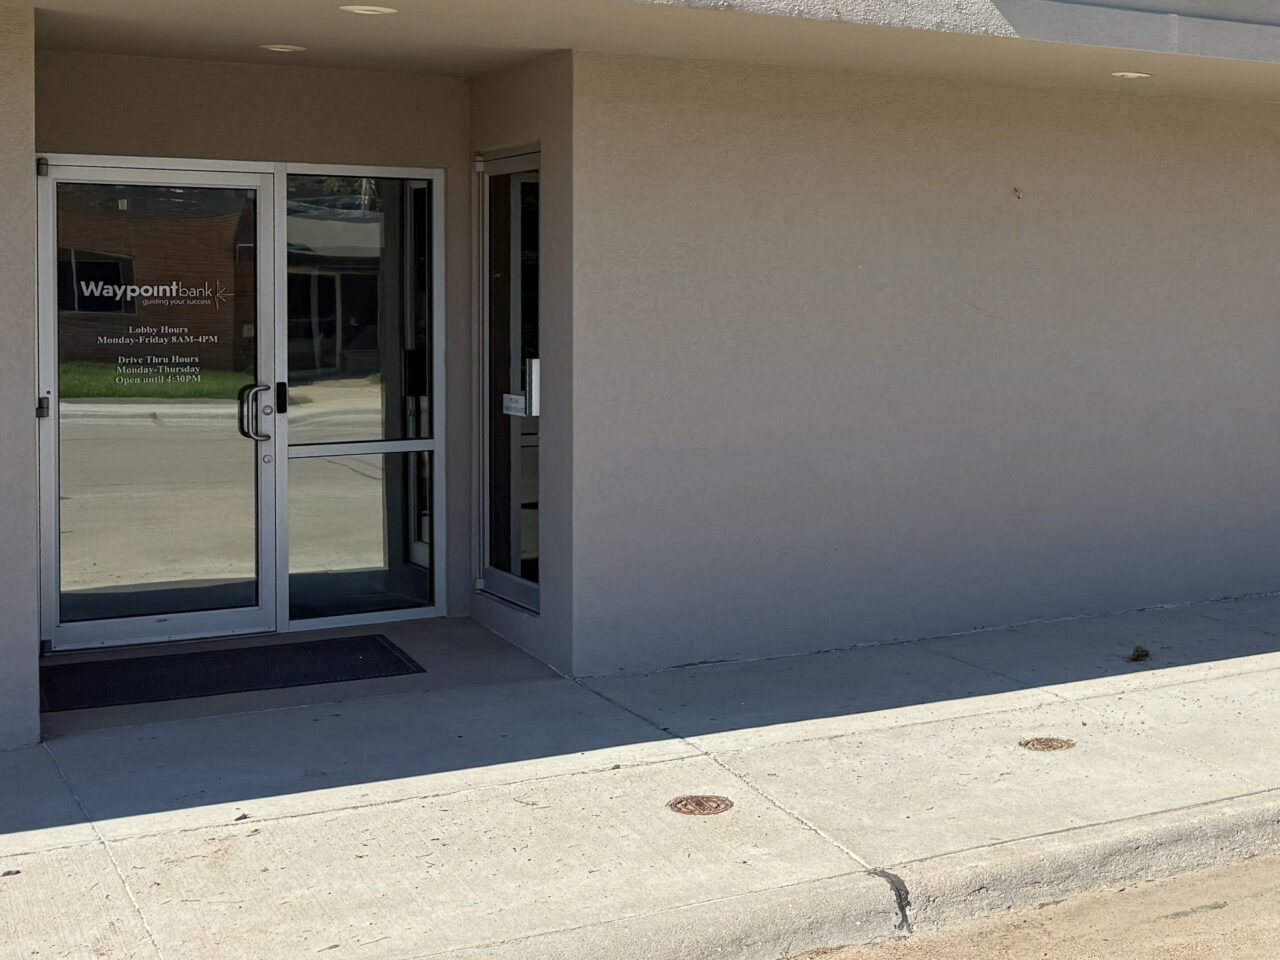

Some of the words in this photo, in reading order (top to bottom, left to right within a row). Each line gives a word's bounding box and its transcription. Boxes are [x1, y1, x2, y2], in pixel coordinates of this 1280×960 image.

[142, 298, 169, 306] guiding
[129, 325, 158, 334] Lobby
[161, 325, 188, 333] Hours
[97, 335, 170, 345] Monday-Friday
[171, 335, 218, 344] 8AM-4PM
[118, 355, 143, 364] Drive
[146, 355, 168, 364] Thru
[172, 355, 199, 363] Hours
[116, 365, 200, 374] Monday-Thursday
[115, 376, 140, 385] Open
[143, 375, 164, 384] until
[166, 374, 201, 383] 4:30PM
